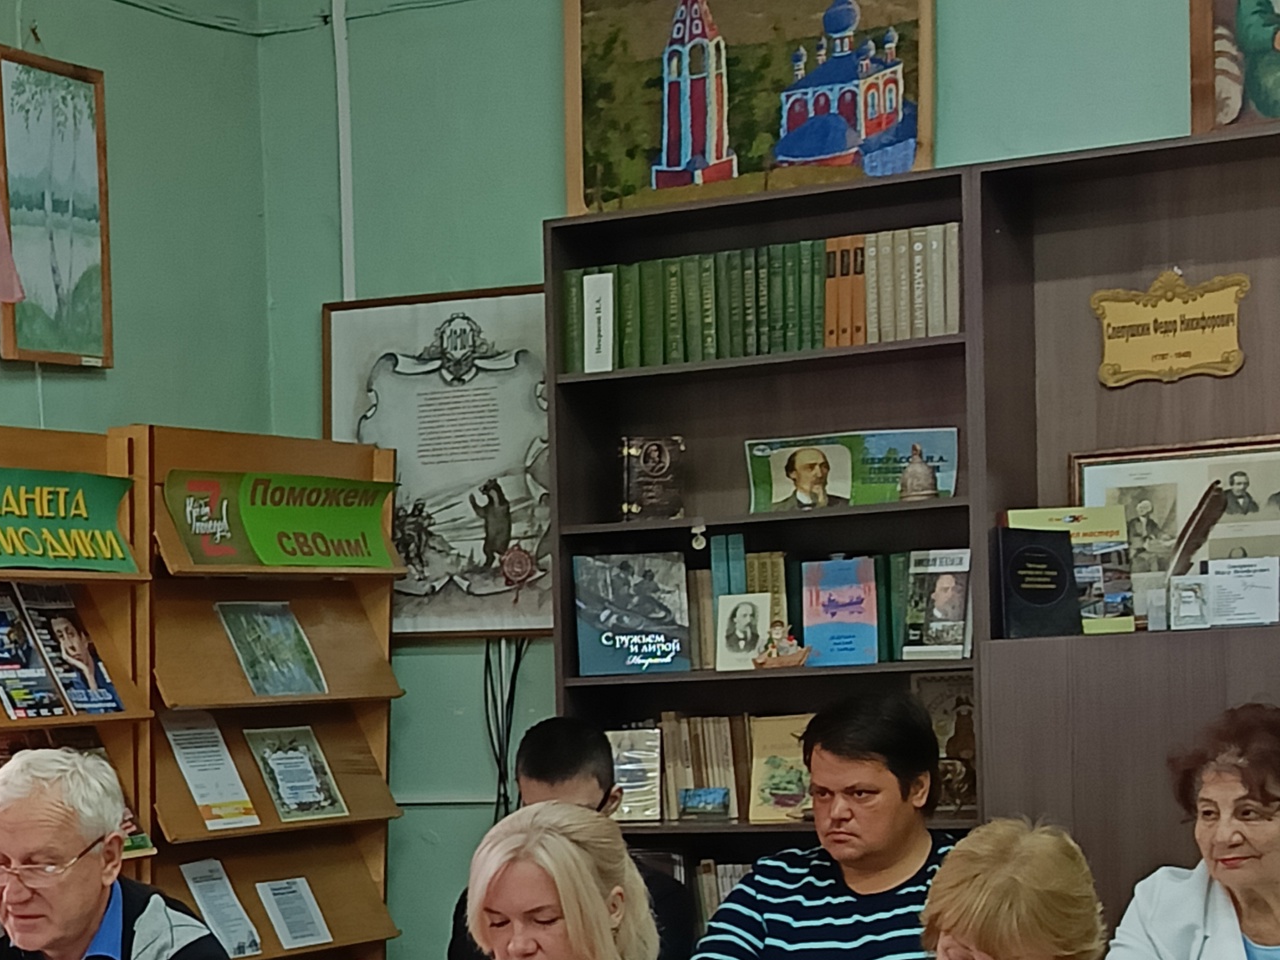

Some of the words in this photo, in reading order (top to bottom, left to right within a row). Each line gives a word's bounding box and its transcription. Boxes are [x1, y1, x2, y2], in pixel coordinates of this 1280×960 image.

[1106, 322, 1151, 343] Слепушкин
[1179, 311, 1236, 334] Никифорович
[250, 478, 380, 508] Поможем
[276, 532, 372, 558] СВОим!
[601, 632, 614, 645] С
[630, 644, 639, 653] и
[640, 639, 681, 656] лирой
